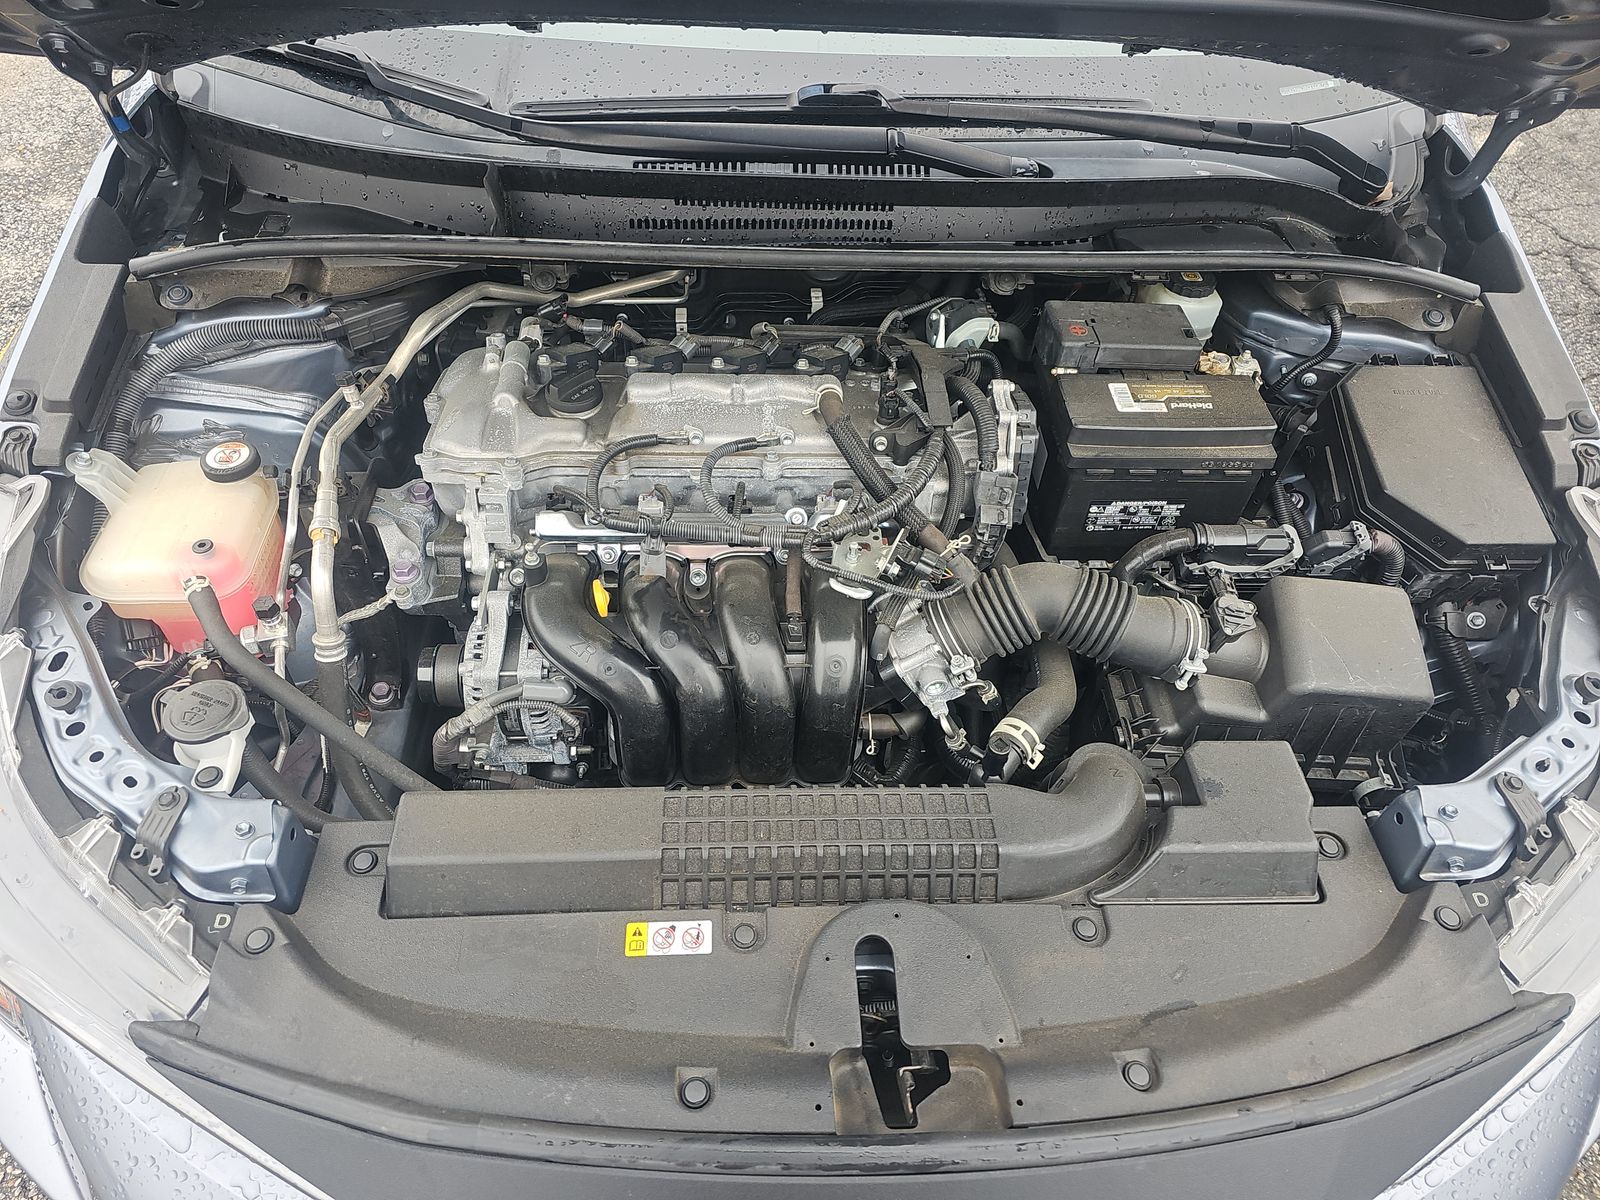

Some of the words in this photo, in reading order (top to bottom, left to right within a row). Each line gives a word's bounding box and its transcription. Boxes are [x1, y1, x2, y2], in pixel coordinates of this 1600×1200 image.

[567, 630, 597, 665] ZR
[1471, 891, 1490, 907] D
[213, 912, 232, 929] D
